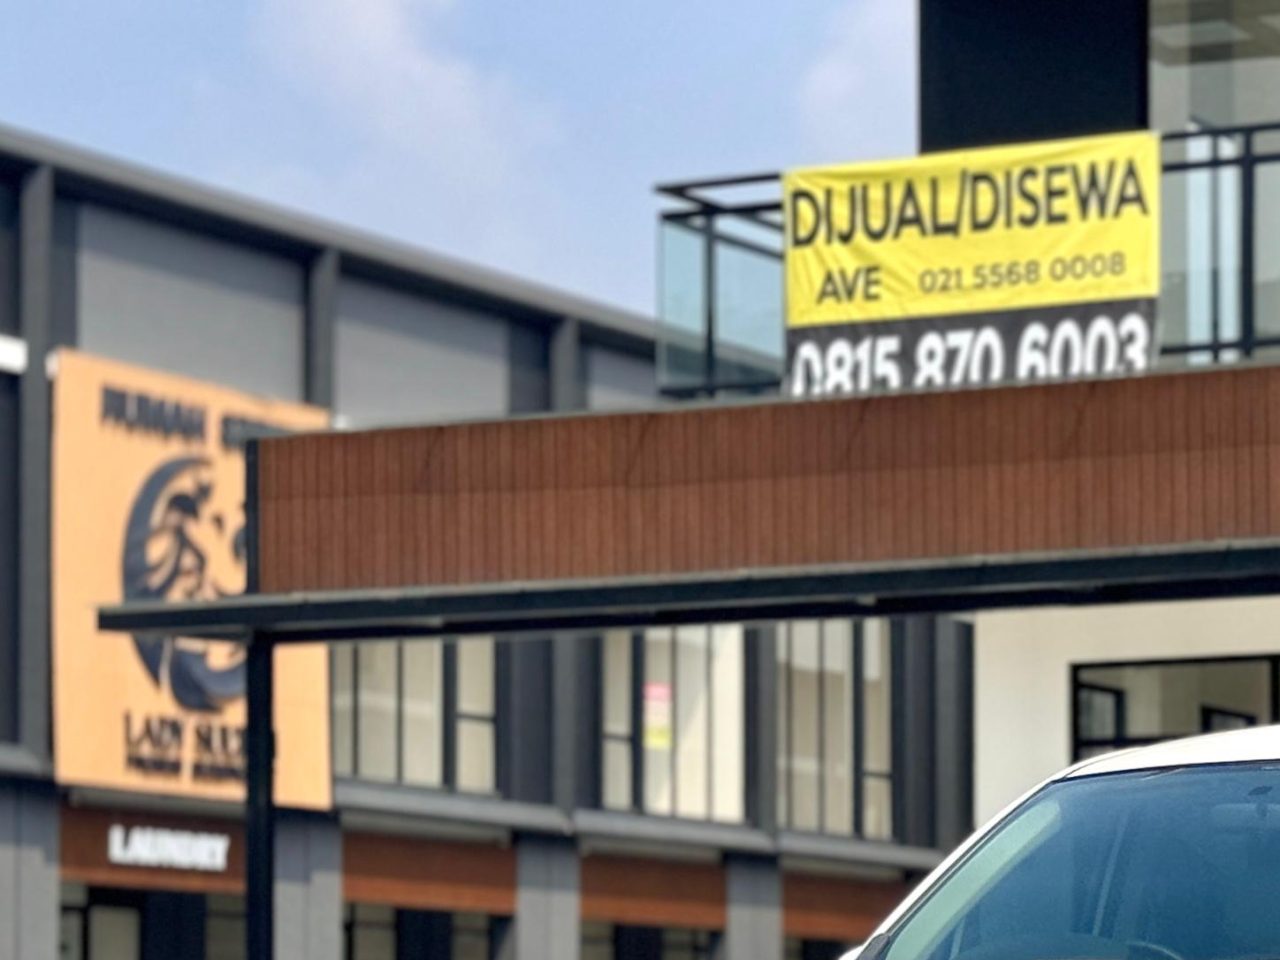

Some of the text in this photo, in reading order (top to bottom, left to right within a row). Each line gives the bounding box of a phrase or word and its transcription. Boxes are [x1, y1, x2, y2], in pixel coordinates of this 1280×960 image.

[790, 157, 1149, 248] DIJUAL/DISEWA
[817, 251, 1126, 304] AVE 021 5568 0008
[791, 312, 1150, 396] 0815 870 6003
